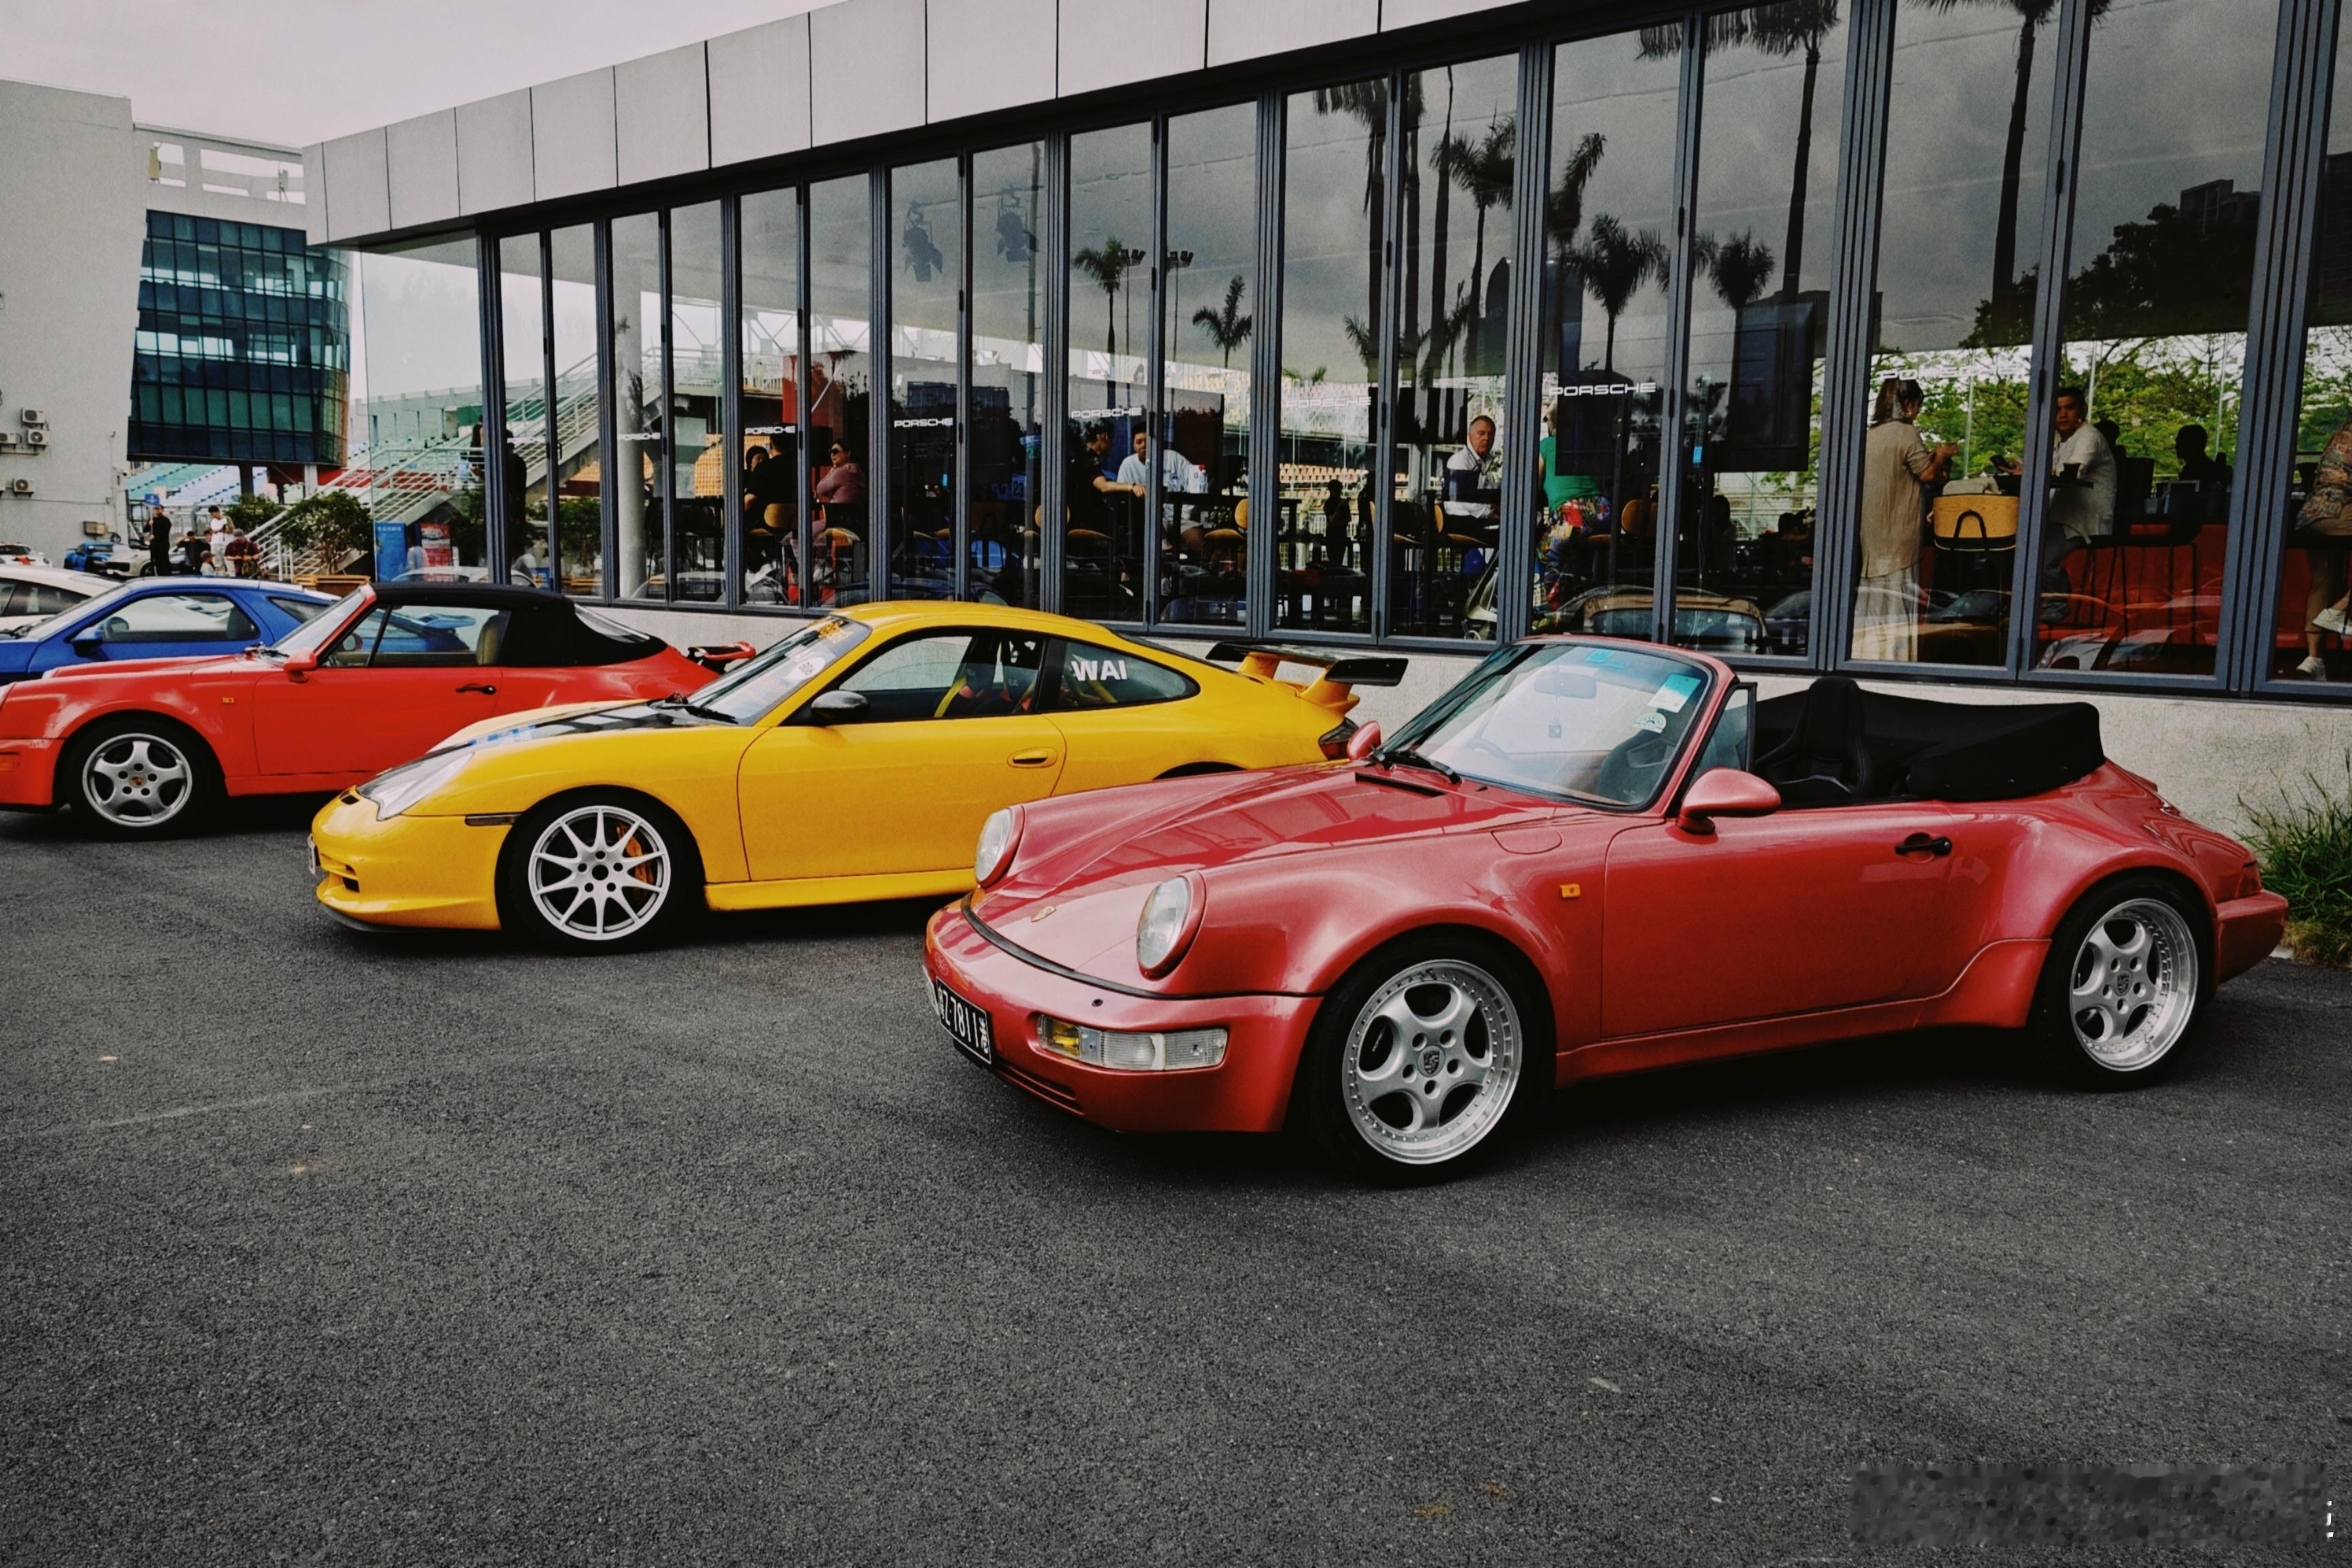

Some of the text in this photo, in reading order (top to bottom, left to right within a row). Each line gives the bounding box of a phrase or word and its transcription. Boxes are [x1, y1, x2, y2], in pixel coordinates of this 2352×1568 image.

[1549, 382, 1656, 397] PORSCHE
[1286, 396, 1371, 408] PORSCHE
[1071, 407, 1143, 419] PORSCHE
[894, 418, 953, 427] PORSCHE
[745, 425, 796, 435] PORSCHE
[1071, 659, 1128, 681] WAI
